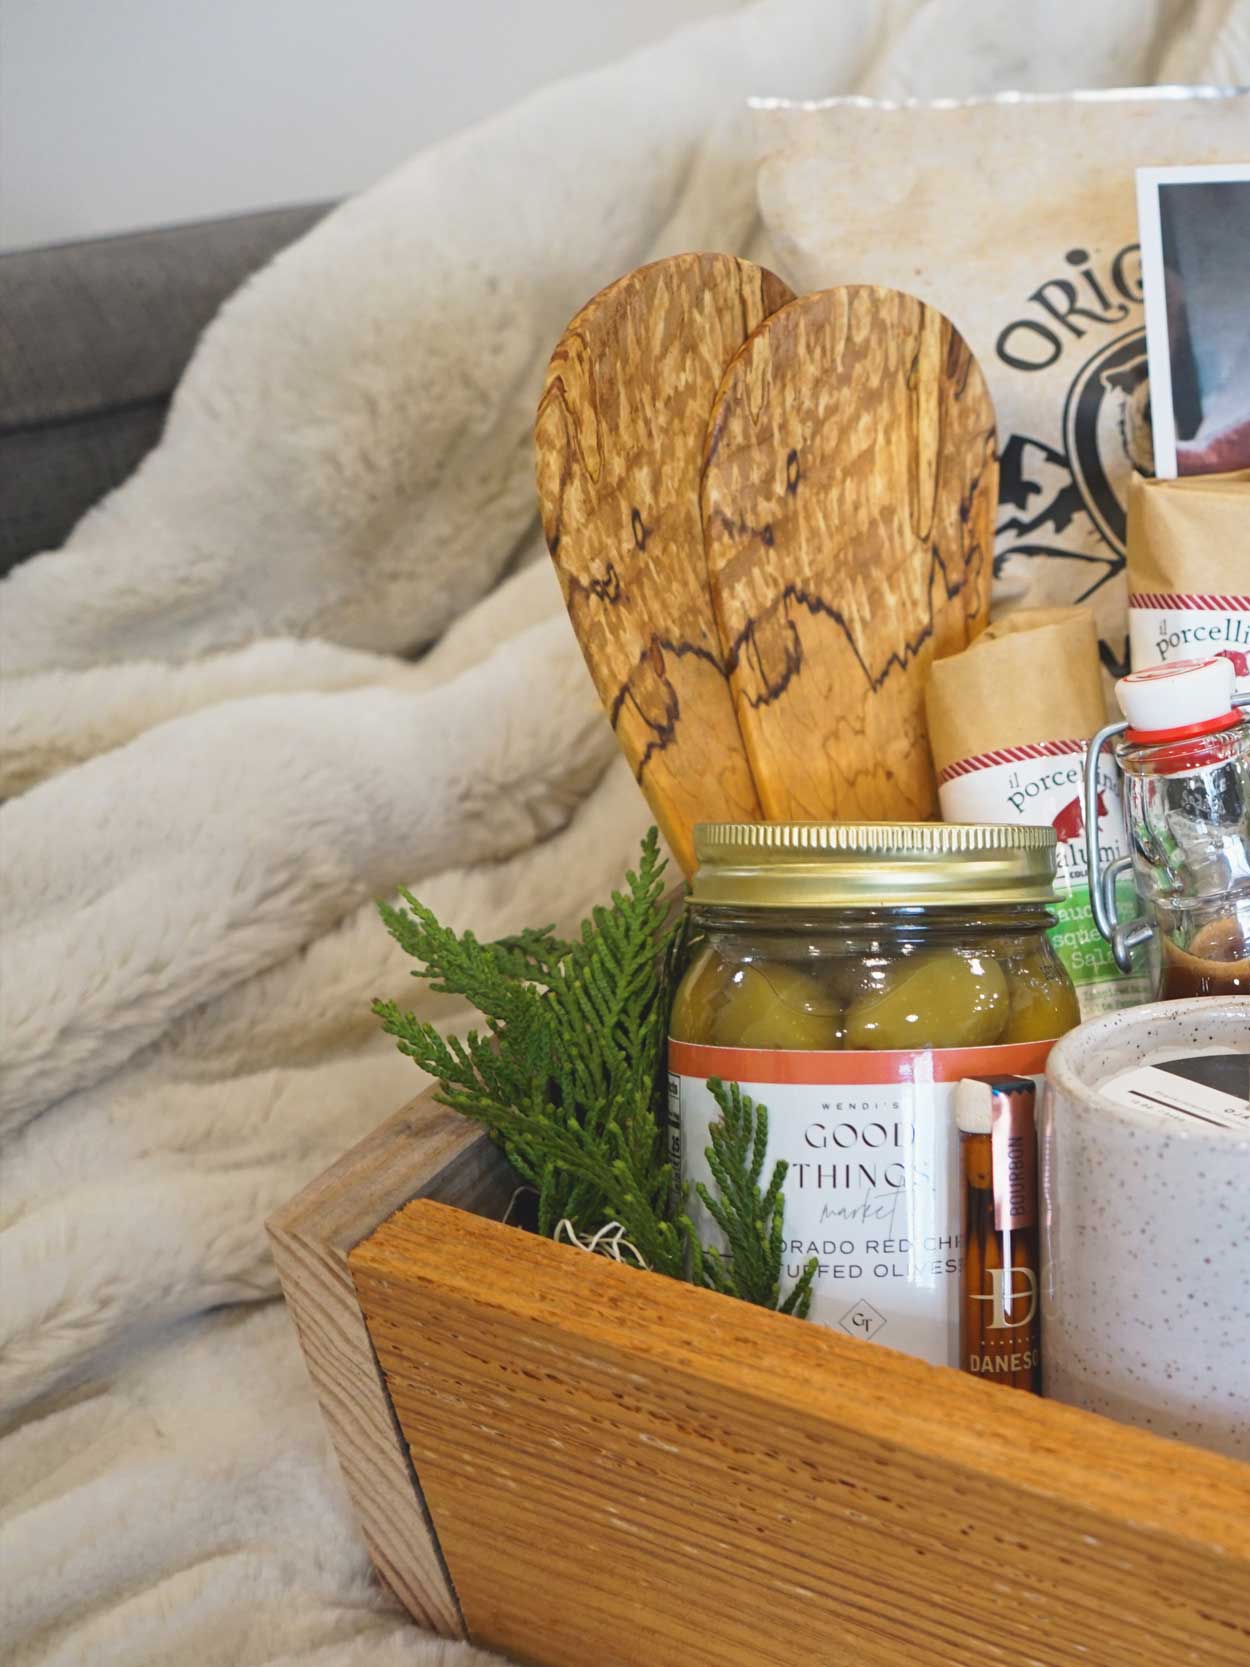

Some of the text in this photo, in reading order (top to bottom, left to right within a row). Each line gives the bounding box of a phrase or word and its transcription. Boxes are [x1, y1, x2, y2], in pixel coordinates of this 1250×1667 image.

[1056, 839, 1121, 868] alumi
[822, 1102, 900, 1111] WENDI'S
[804, 1122, 916, 1149] GOOD
[1008, 1136, 1024, 1217] BOURBON
[819, 1187, 909, 1241] market
[866, 1239, 911, 1254] RED
